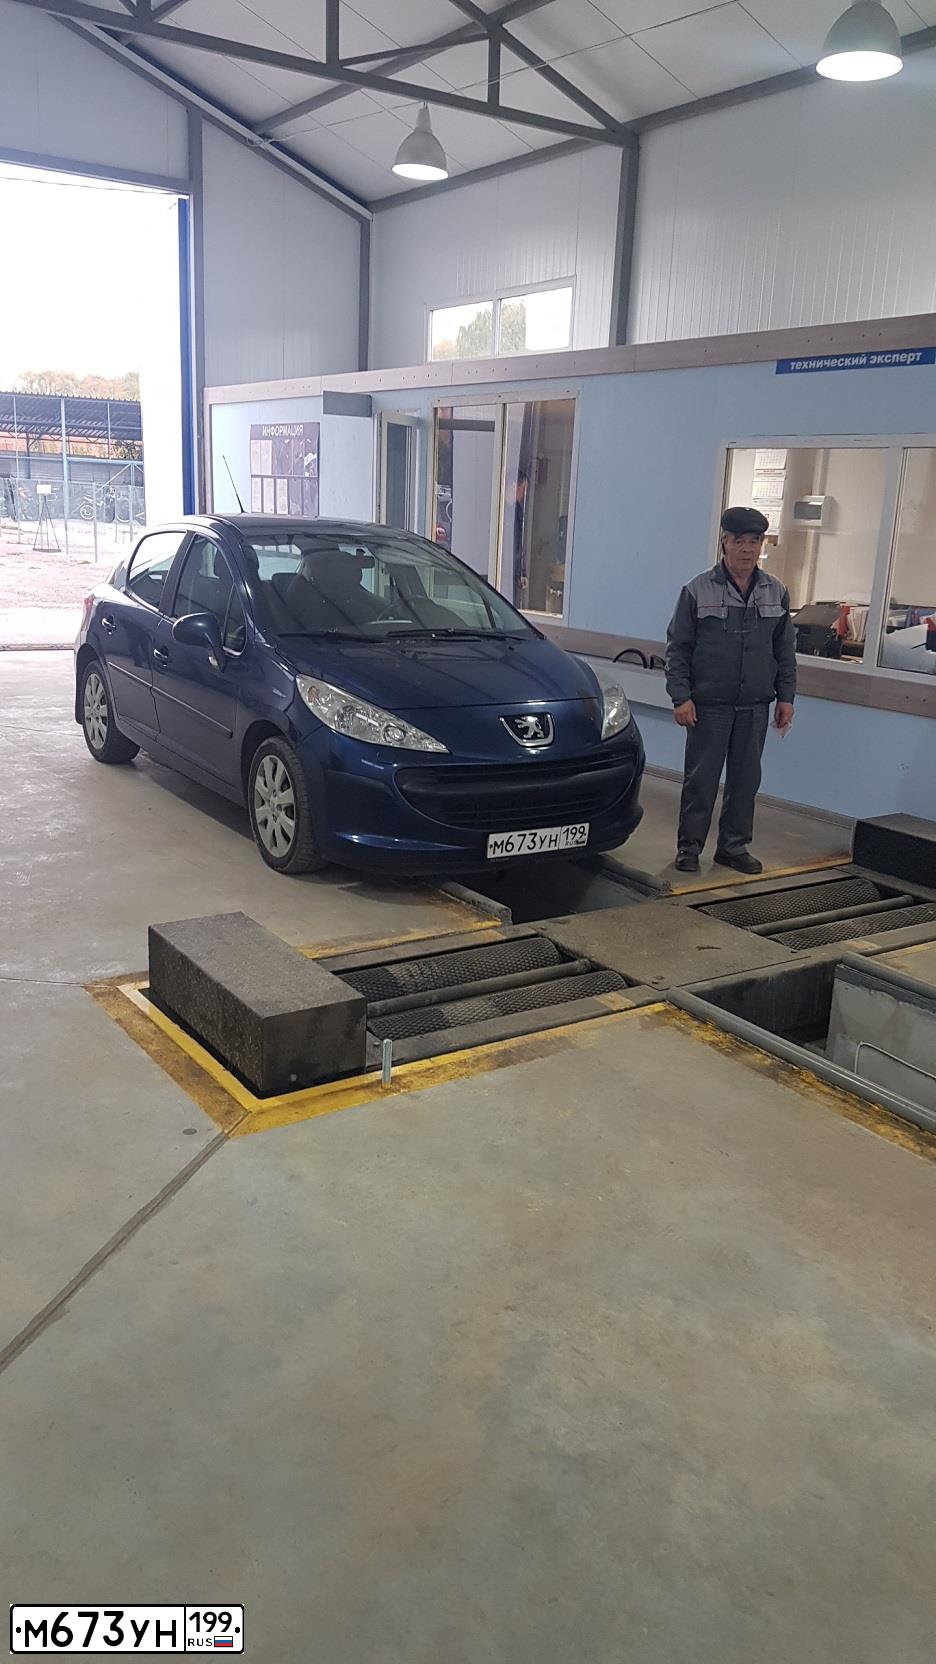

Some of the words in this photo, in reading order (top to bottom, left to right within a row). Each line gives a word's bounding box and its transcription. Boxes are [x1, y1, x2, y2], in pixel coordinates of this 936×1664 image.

[790, 354, 867, 370] технический
[869, 352, 922, 364] эксперт
[262, 424, 304, 437] ИНФОРМАЦИЯ
[563, 825, 585, 840] 199
